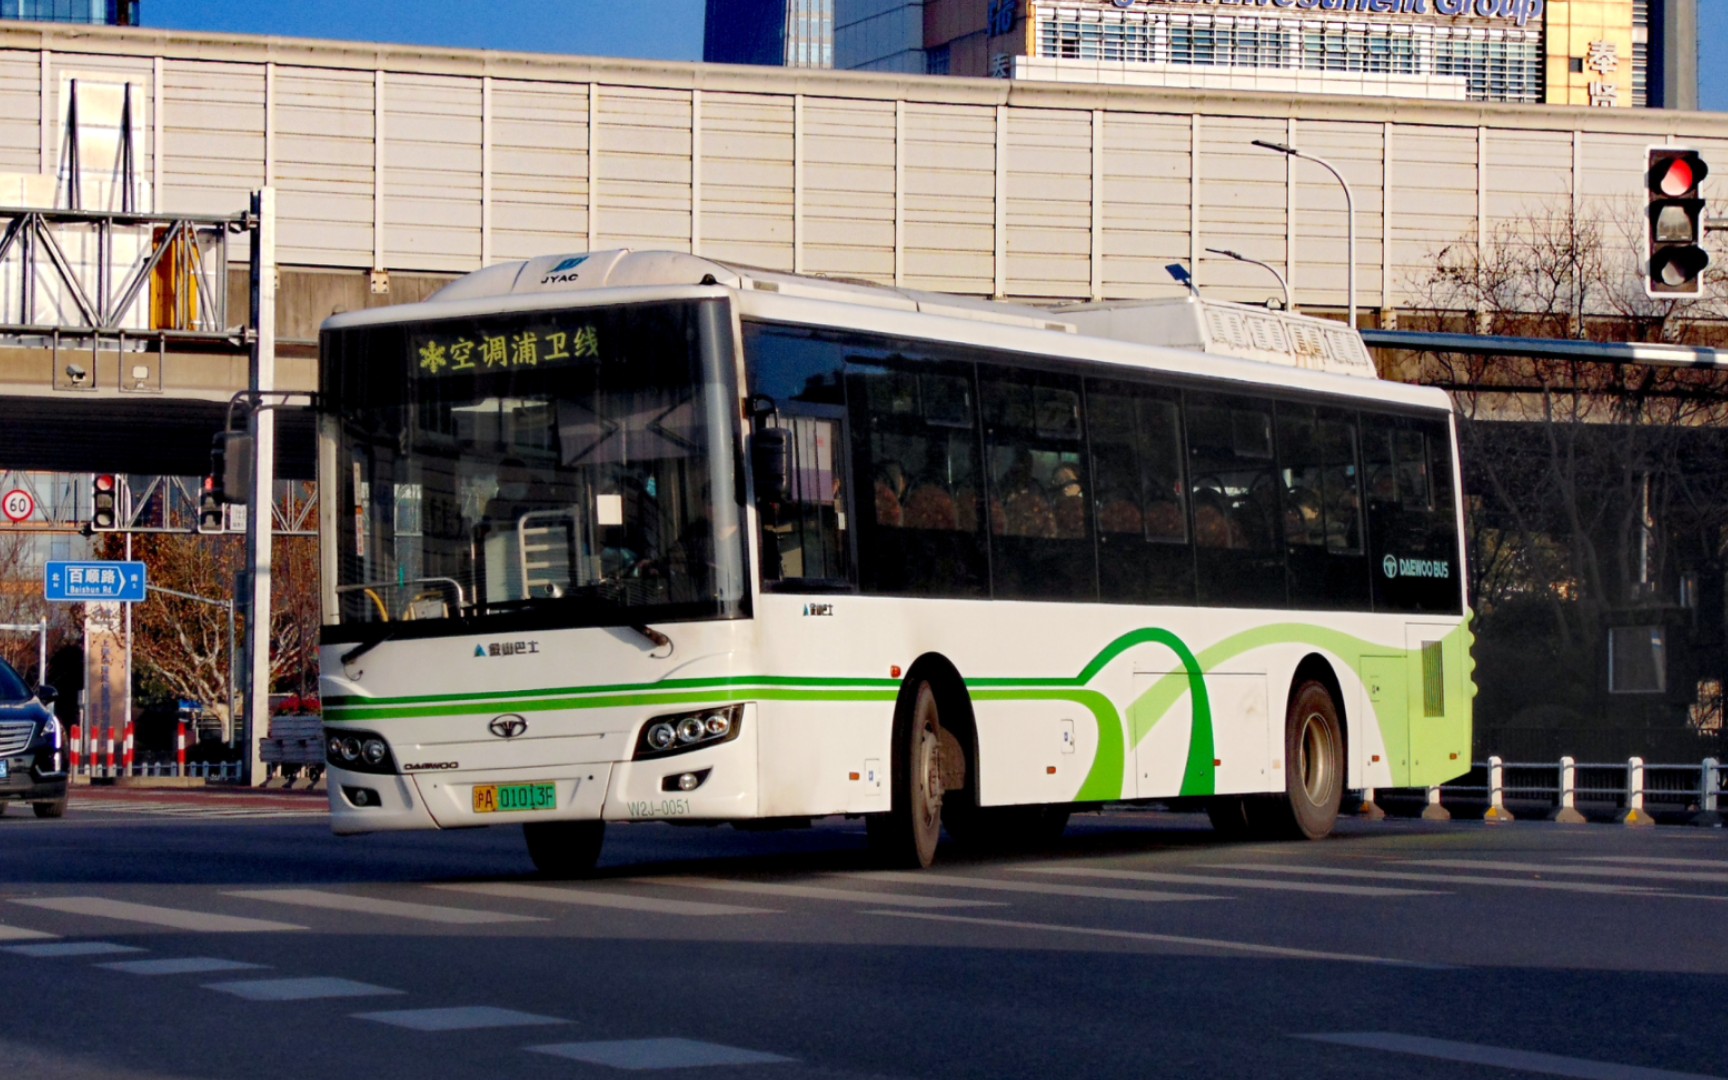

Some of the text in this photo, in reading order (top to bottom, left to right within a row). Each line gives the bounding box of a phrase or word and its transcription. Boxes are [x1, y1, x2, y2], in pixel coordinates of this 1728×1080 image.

[1436, 0, 1543, 26] Group
[540, 273, 579, 285] JYAC
[450, 325, 599, 370] 空调浦卫线
[10, 498, 26, 512] 60
[69, 568, 115, 584] 百顺路
[1399, 559, 1449, 578] DAEWOO BUS
[403, 761, 459, 770] DAEWOO
[500, 786, 554, 807] 01013F
[627, 799, 691, 817] W2J-0051
